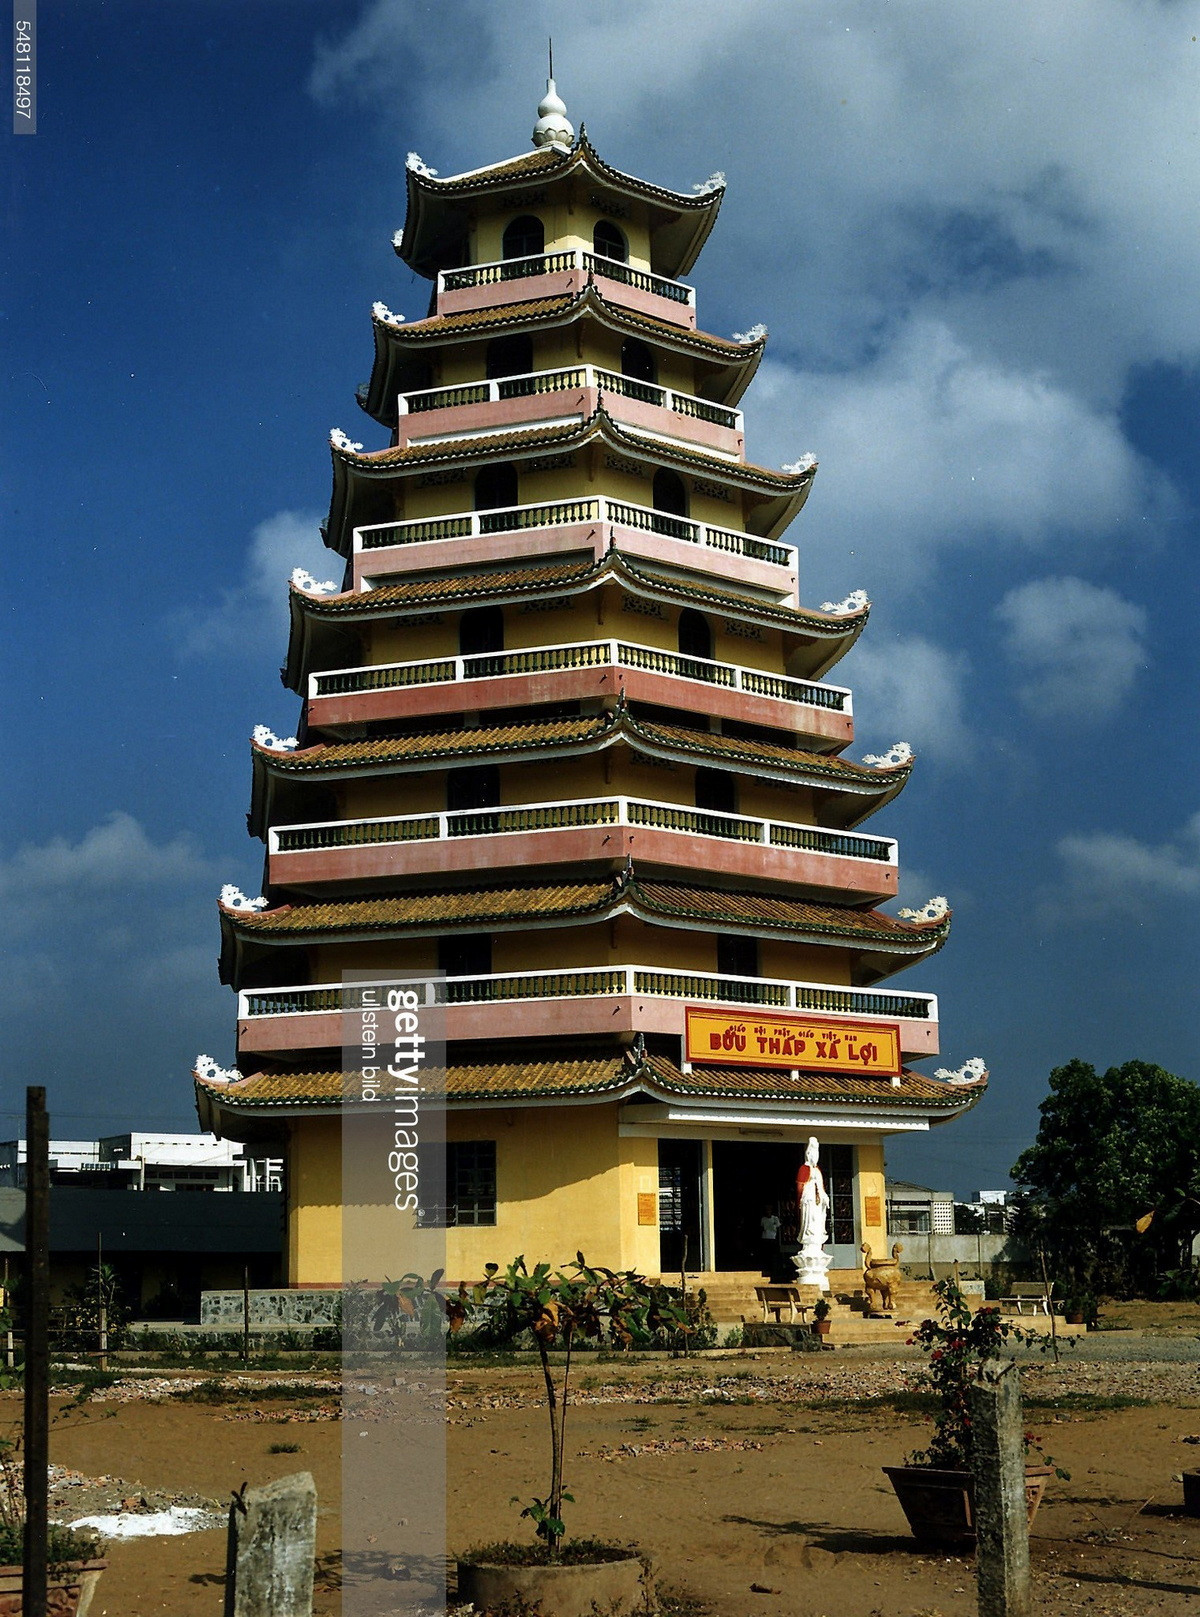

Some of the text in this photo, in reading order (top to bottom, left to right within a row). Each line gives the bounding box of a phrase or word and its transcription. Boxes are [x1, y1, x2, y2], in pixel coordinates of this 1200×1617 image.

[757, 1034, 806, 1056] THÁP
[816, 1038, 842, 1060] XÁ
[848, 1042, 878, 1066] LỢI
